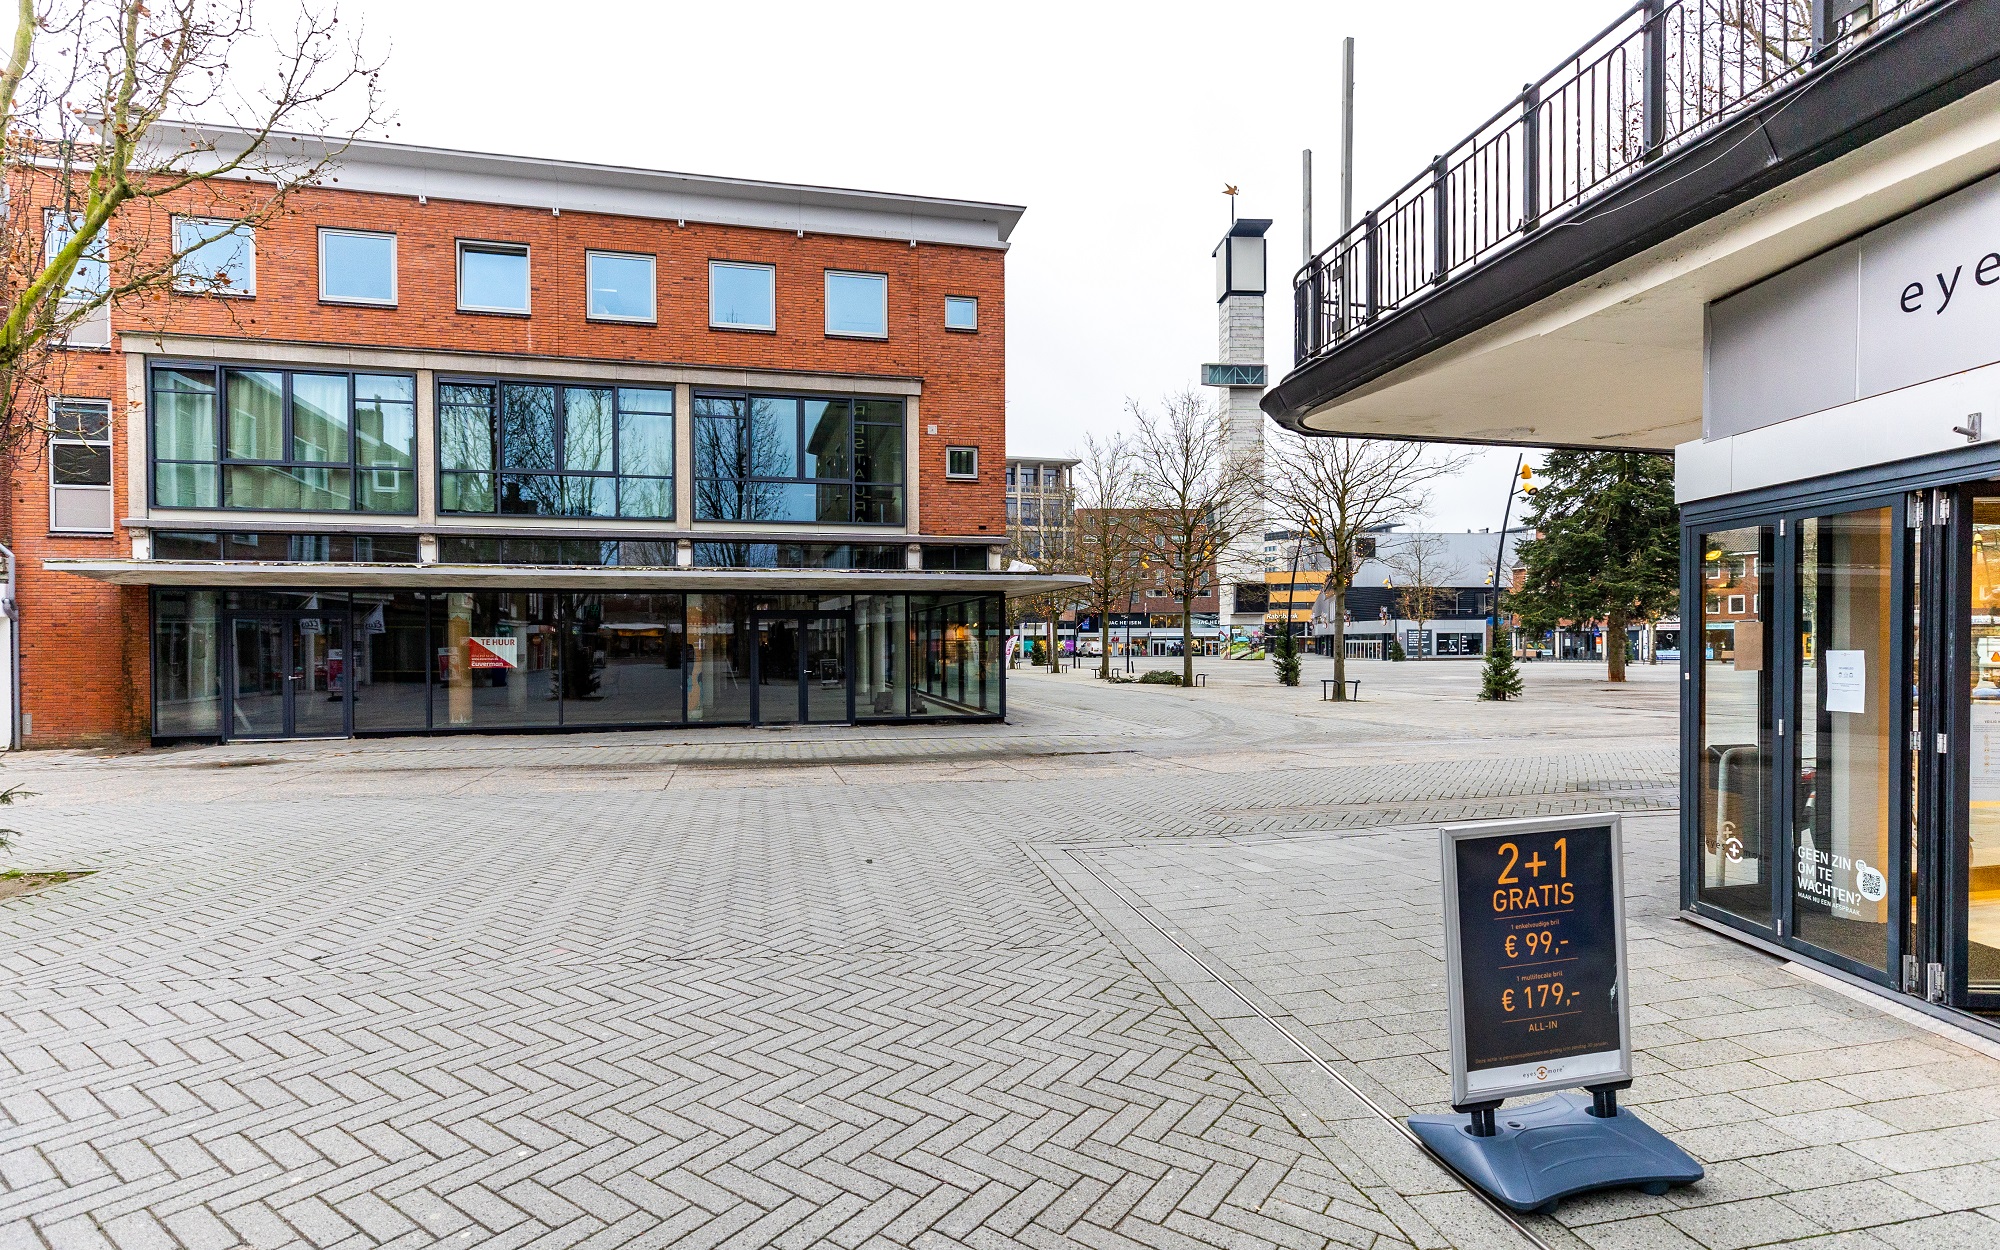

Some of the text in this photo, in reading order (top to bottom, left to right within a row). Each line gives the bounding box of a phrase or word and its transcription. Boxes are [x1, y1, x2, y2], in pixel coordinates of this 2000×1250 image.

[1498, 837, 1567, 885] 2+1
[1797, 846, 1851, 871] GEEN ZIN
[1797, 861, 1833, 882] OM TE
[1493, 882, 1575, 912] GRATIS
[1797, 876, 1862, 906] WACHTEN?
[1797, 891, 1812, 901] MAAK
[1812, 896, 1820, 904] NU
[1821, 898, 1832, 907] EEN
[1504, 931, 1569, 958] € 99,-
[1501, 982, 1580, 1012] € 179,-
[1528, 1020, 1558, 1032] ALL-IN
